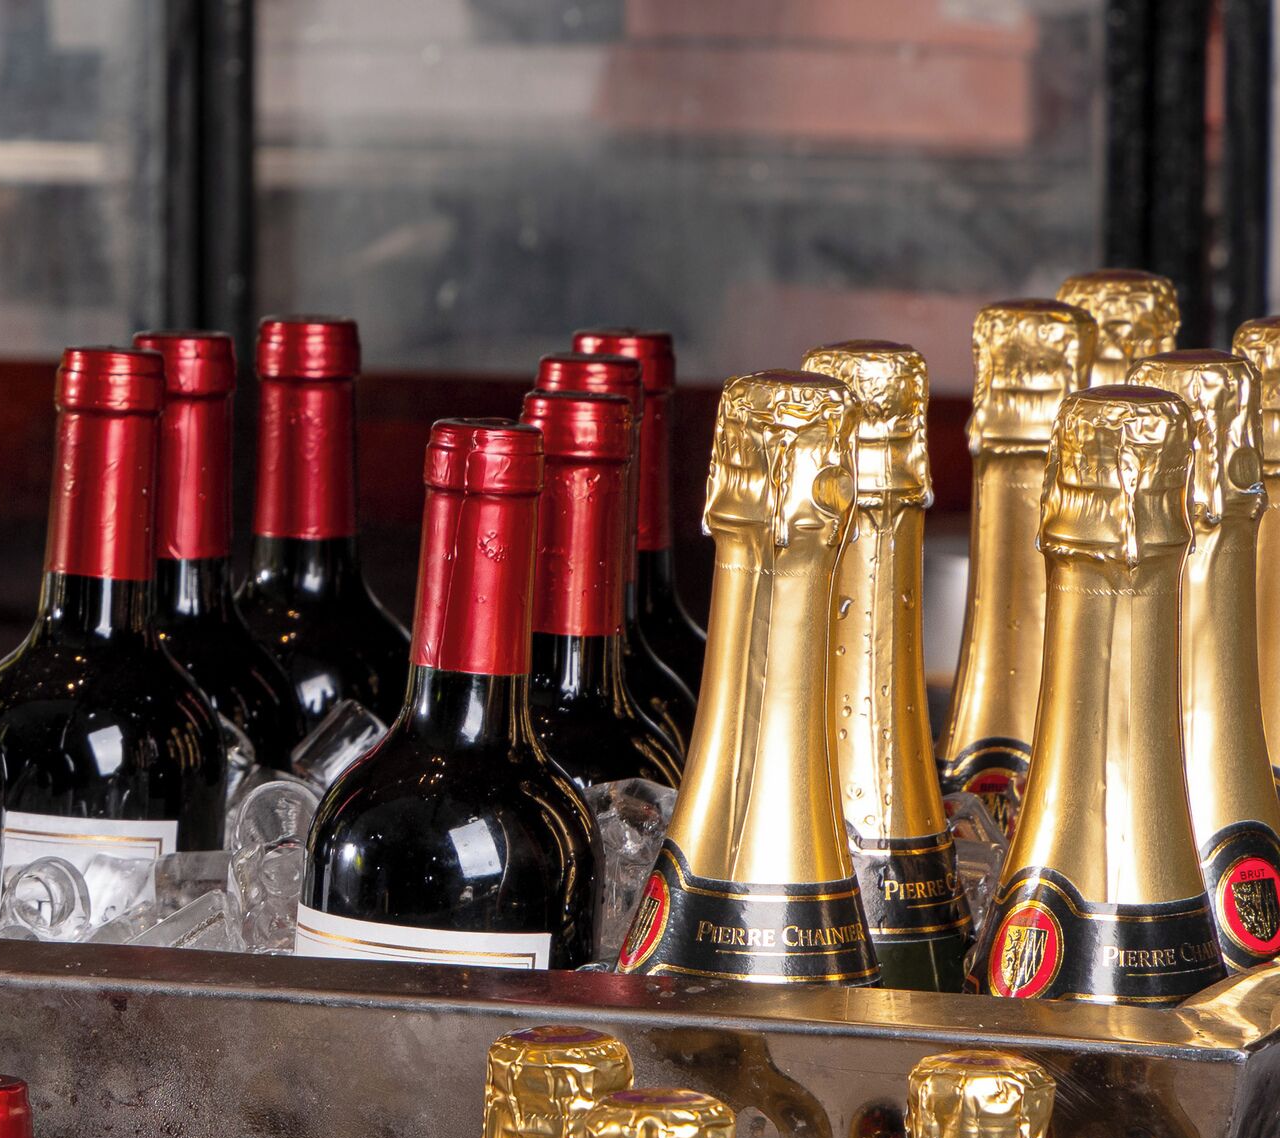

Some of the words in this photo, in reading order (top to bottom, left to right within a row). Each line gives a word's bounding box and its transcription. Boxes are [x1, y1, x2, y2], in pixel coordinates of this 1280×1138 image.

[1240, 869, 1265, 881] BRUT
[696, 919, 776, 948] PIERRE
[781, 922, 865, 948] CHAINIER
[1102, 944, 1176, 968] PIERRE
